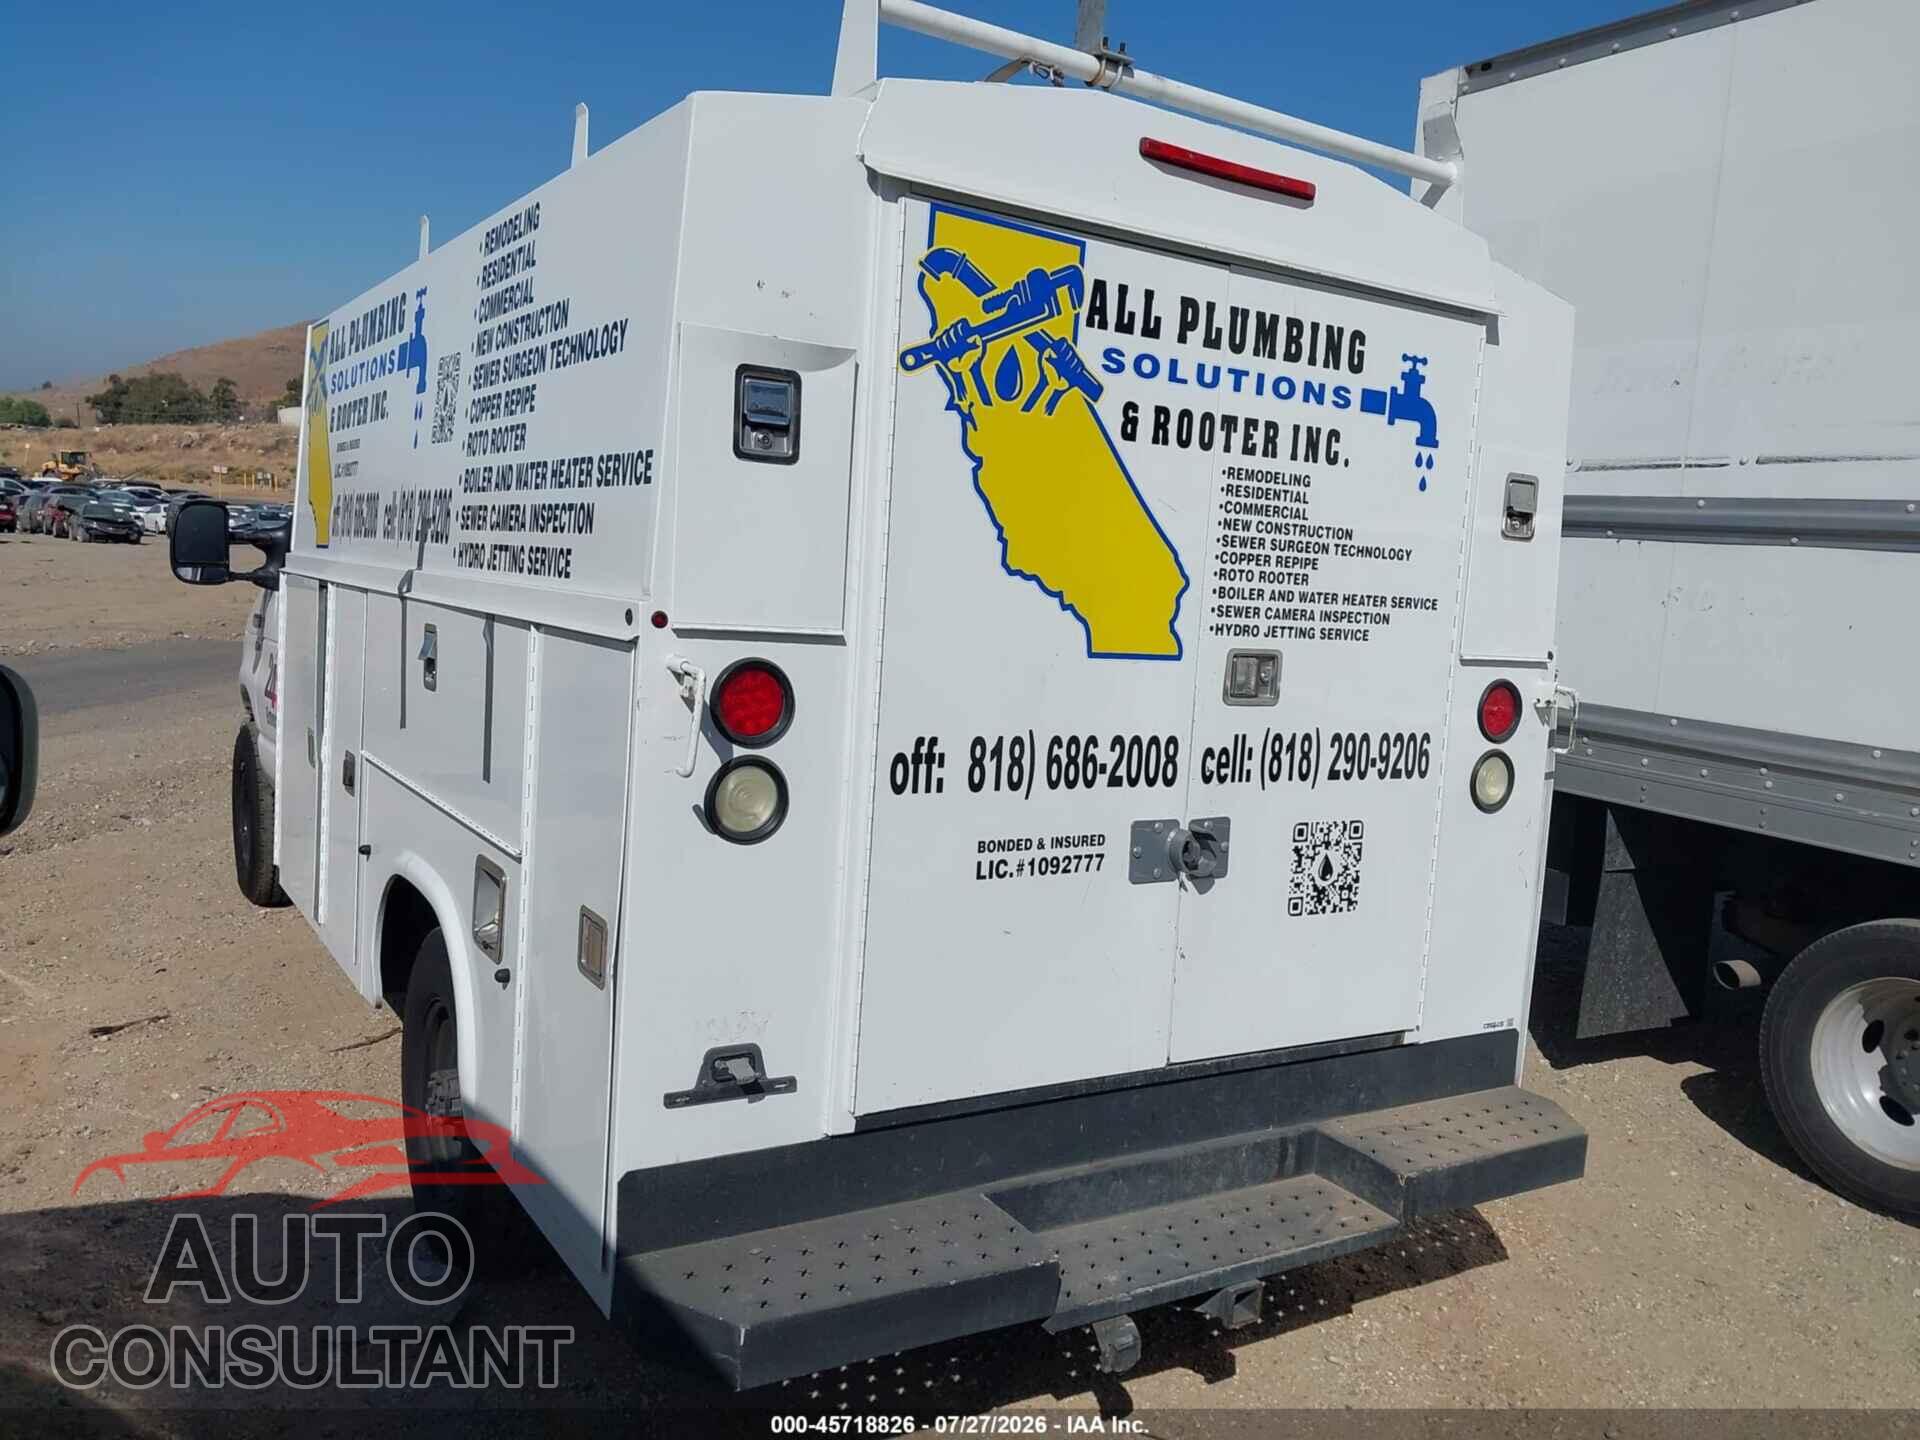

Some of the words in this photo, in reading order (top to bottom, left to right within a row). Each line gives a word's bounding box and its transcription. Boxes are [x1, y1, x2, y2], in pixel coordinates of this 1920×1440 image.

[484, 201, 541, 256] REMODELING
[481, 240, 537, 290] RESIDENTIAL
[478, 276, 534, 324] COMMERCIAL
[329, 325, 346, 365] ALL
[348, 292, 407, 356] PLUMBING
[475, 327, 495, 357] NEW
[495, 298, 570, 351] CONSTRUCTION
[1085, 278, 1162, 340] ALL
[1177, 295, 1366, 374] PLUMBING
[330, 348, 396, 394] SOLUTIONS
[472, 358, 501, 391] SEWER
[502, 343, 548, 384] SURGEON
[550, 317, 629, 370] TECHNOLOGY
[1101, 347, 1352, 409] SOLUTIONS
[336, 396, 369, 431] ROOTER
[470, 392, 502, 424] COPPER
[503, 383, 537, 417] REPIPE
[467, 429, 489, 457] ROTO
[490, 422, 527, 454] ROOTER
[1120, 401, 1139, 442] &
[1151, 404, 1280, 460] ROOTER
[1290, 423, 1350, 468] INC.
[463, 466, 493, 493] BOILER
[494, 464, 514, 491] AND
[515, 460, 548, 491] WATER
[550, 456, 594, 489] HEATER
[596, 449, 654, 488] SERVICE
[1227, 467, 1311, 488] REMODELING
[1224, 501, 1309, 521] COMMERCIAL
[1225, 484, 1309, 504] RESIDENTIAL
[460, 504, 488, 531] SEWER
[490, 503, 526, 532] CAMERA
[529, 502, 595, 534] INSPECTION
[1223, 518, 1251, 532] NEW
[1256, 520, 1353, 541] CONSTRUCTION
[458, 542, 485, 569] HYDRO
[487, 544, 525, 574] JETTING
[527, 546, 572, 579] SERVICE
[1219, 551, 1271, 567] COPPER
[1275, 556, 1319, 570] REPIPE
[1221, 534, 1266, 550] SEWER
[1270, 537, 1330, 555] SURGEON
[1334, 543, 1413, 561] TECHNOLOGY
[1218, 568, 1254, 582] ROTO
[1258, 571, 1309, 586] ROOTER
[1216, 604, 1260, 619] SEWER
[1264, 607, 1315, 621] CAMERA
[1319, 610, 1391, 625] INSPECTION
[1218, 586, 1265, 602] BOILER
[1268, 589, 1295, 603] AND
[1298, 591, 1338, 606] WATER
[1342, 593, 1387, 608] HEATER
[1390, 596, 1438, 611] SERVICE
[1214, 623, 1260, 637] HYDRO
[1264, 625, 1316, 640] JETTING
[1319, 627, 1370, 642] SERVICE
[889, 736, 945, 795] off:
[967, 729, 1035, 800] 818)
[1046, 734, 1179, 790] 686-2008
[1200, 733, 1253, 785] cell:
[1260, 727, 1321, 791] (818)
[1327, 732, 1431, 781] 290-9206
[977, 838, 1033, 854] BONDED
[1036, 837, 1046, 850] &
[1050, 834, 1105, 849] INSURED
[976, 853, 1105, 880] LIC.#1092777
